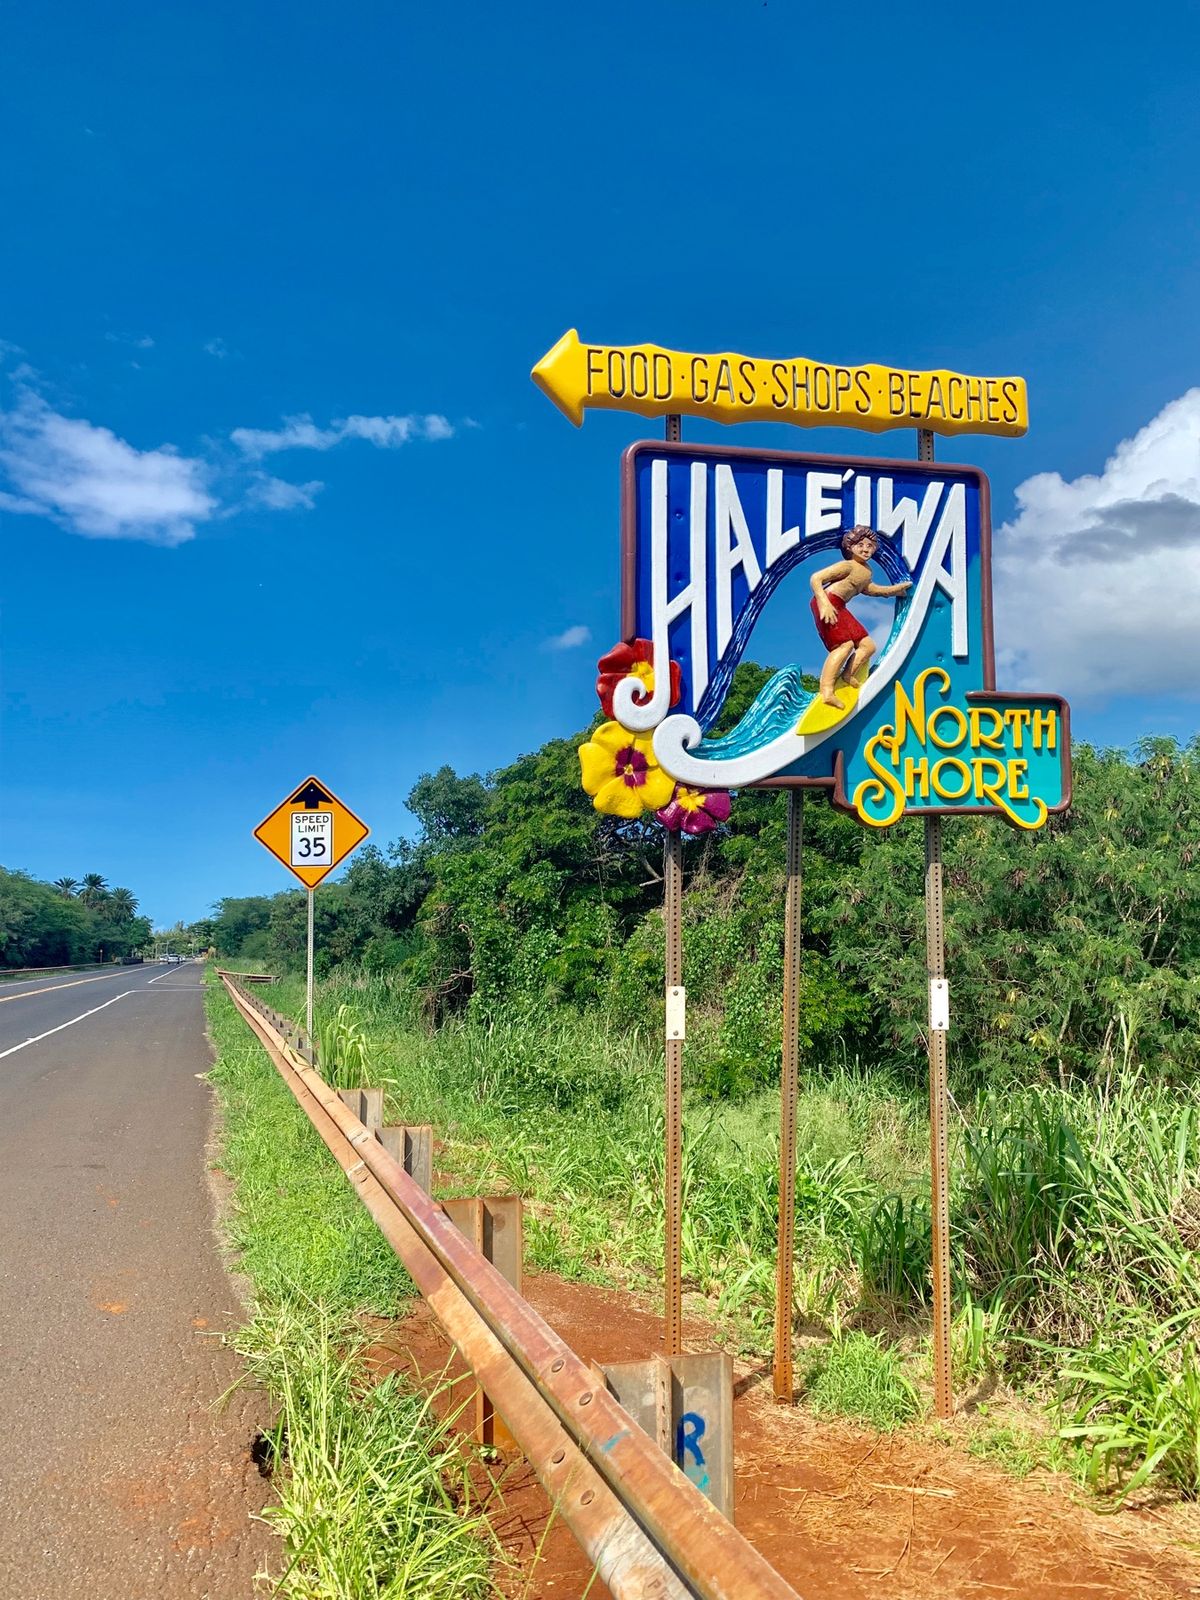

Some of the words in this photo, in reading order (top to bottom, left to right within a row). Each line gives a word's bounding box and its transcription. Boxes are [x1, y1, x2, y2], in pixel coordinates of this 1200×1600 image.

[585, 348, 673, 400] FOOD
[690, 357, 757, 405] GAS
[770, 363, 872, 415] SHOPS
[889, 371, 1020, 424] BEACHES
[894, 667, 1057, 750] NORTH
[853, 724, 1049, 830] SHORE
[295, 815, 329, 824] SPEED
[298, 824, 325, 833] LIMIT
[298, 837, 326, 857] 35
